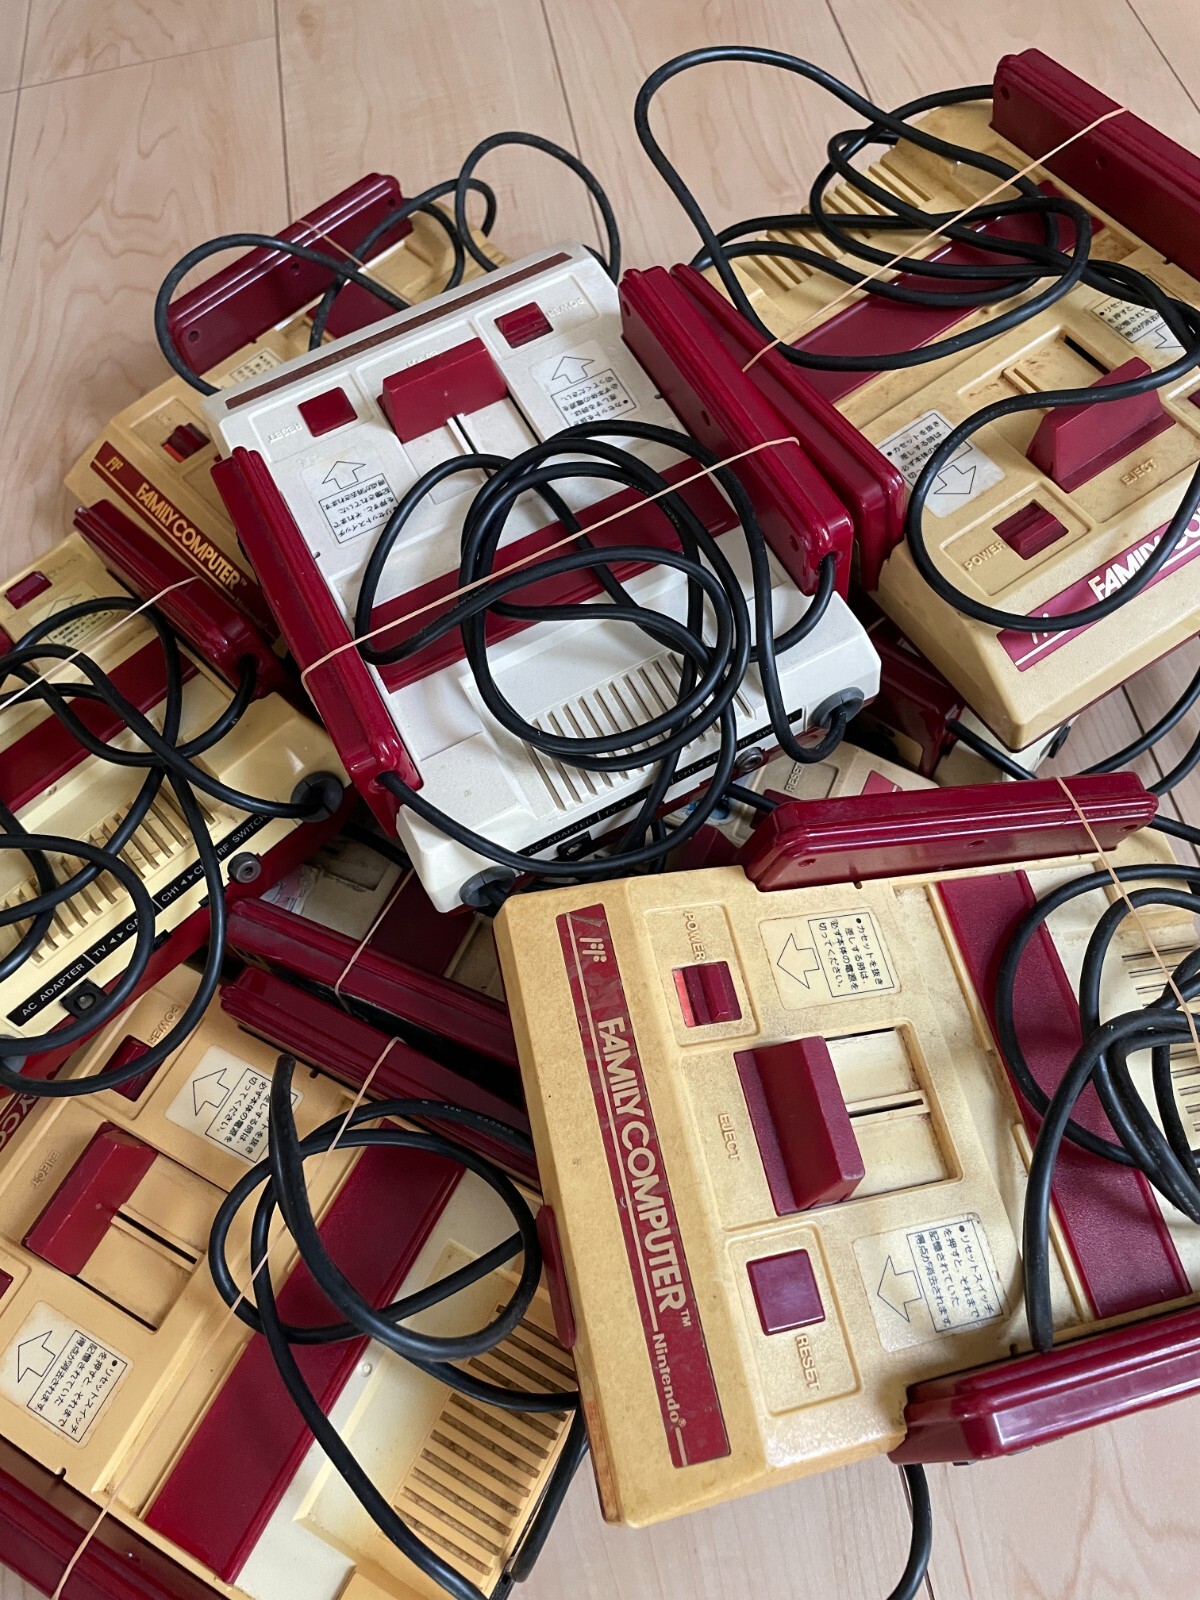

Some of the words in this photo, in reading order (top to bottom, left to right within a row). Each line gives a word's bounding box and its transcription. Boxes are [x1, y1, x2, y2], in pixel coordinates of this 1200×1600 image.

[1121, 458, 1157, 486] EJECT
[963, 541, 1007, 572] POWER
[217, 843, 230, 856] RF
[161, 885, 180, 903] CH1
[92, 944, 108, 957] TV
[684, 911, 706, 961] POWER
[22, 1002, 38, 1016] AC
[40, 963, 85, 1001] ADAPTER
[147, 1004, 180, 1045] POWER
[718, 1112, 740, 1161] EJECT
[31, 1150, 60, 1187] EJECT
[961, 1234, 995, 1315] リセットスイッチ
[795, 1333, 820, 1391] RESET
[71, 1368, 114, 1434] リセットスイッチ
